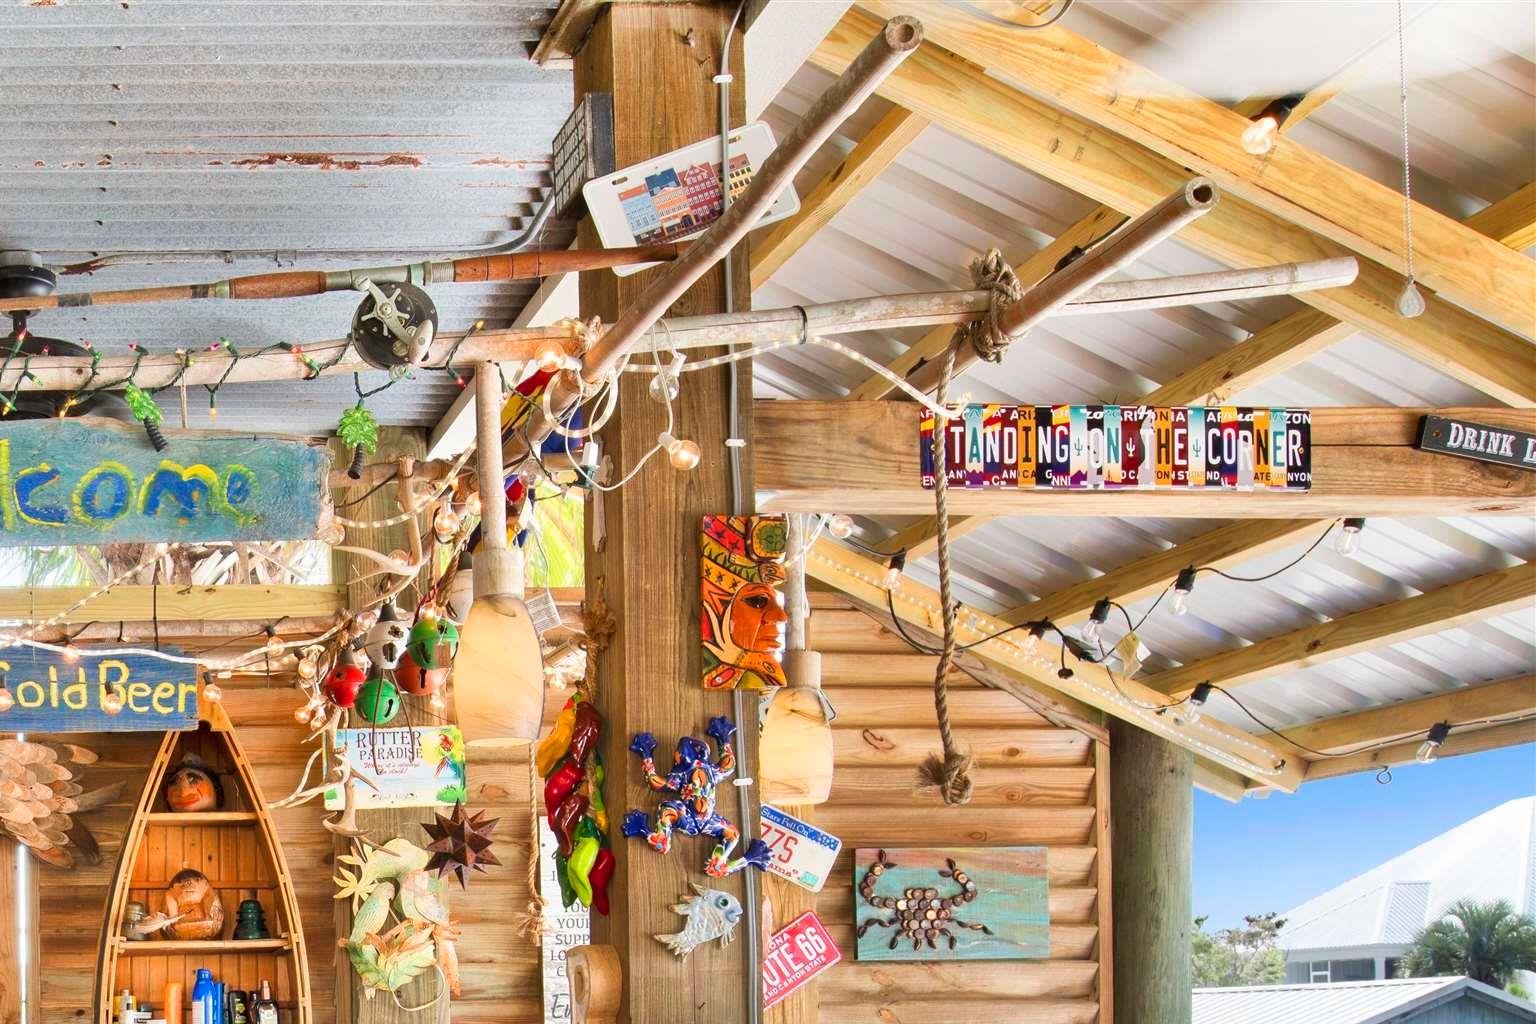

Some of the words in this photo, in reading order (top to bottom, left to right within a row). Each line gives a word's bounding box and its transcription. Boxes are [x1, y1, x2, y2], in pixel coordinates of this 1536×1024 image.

[948, 426, 1068, 464] TANDING
[1140, 427, 1187, 466] THE
[1208, 427, 1302, 469] CORNER
[1447, 423, 1516, 457] DRINK
[98, 658, 197, 714] Beer
[357, 731, 422, 748] RUTTER
[359, 747, 424, 760] PARADISE
[763, 943, 805, 988] UTE
[795, 926, 826, 960] 66
